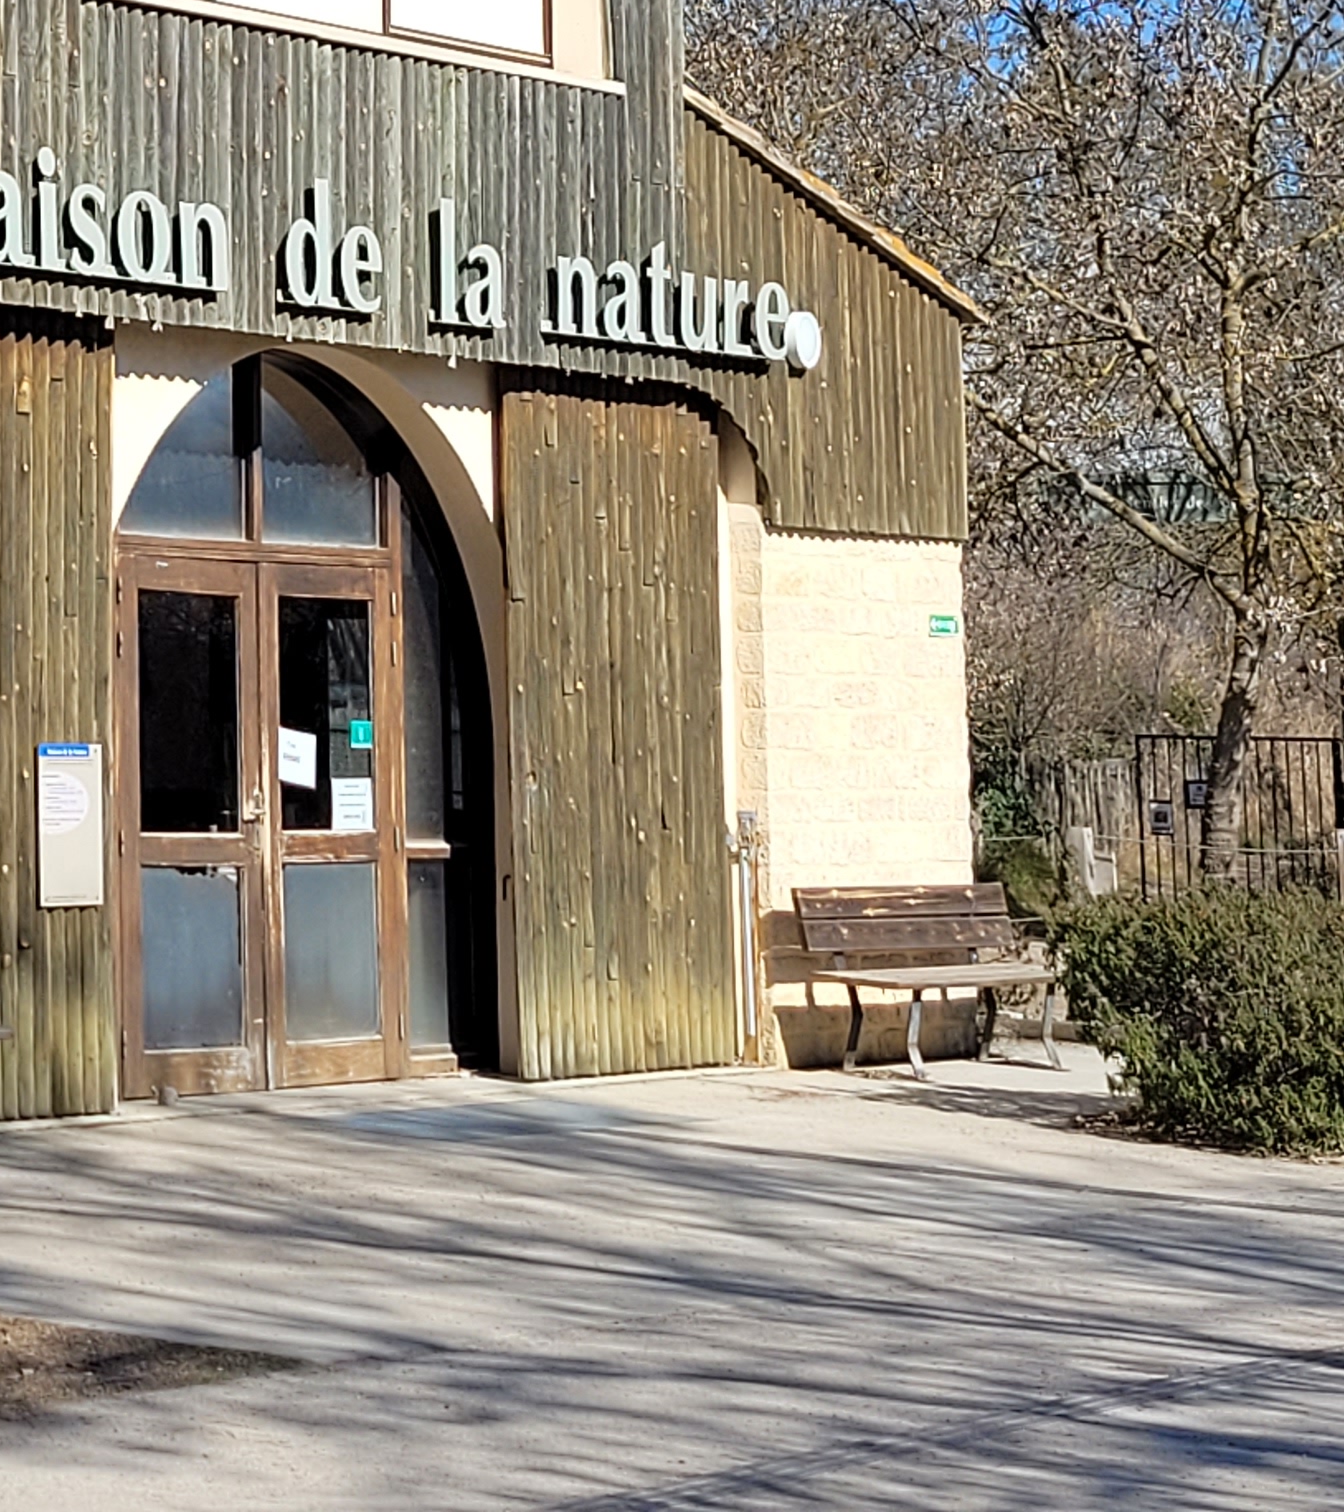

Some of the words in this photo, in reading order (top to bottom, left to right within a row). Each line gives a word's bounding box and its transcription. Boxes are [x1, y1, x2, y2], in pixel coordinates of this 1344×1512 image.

[285, 177, 384, 314] de
[439, 197, 507, 329] la
[556, 240, 791, 362] nature
